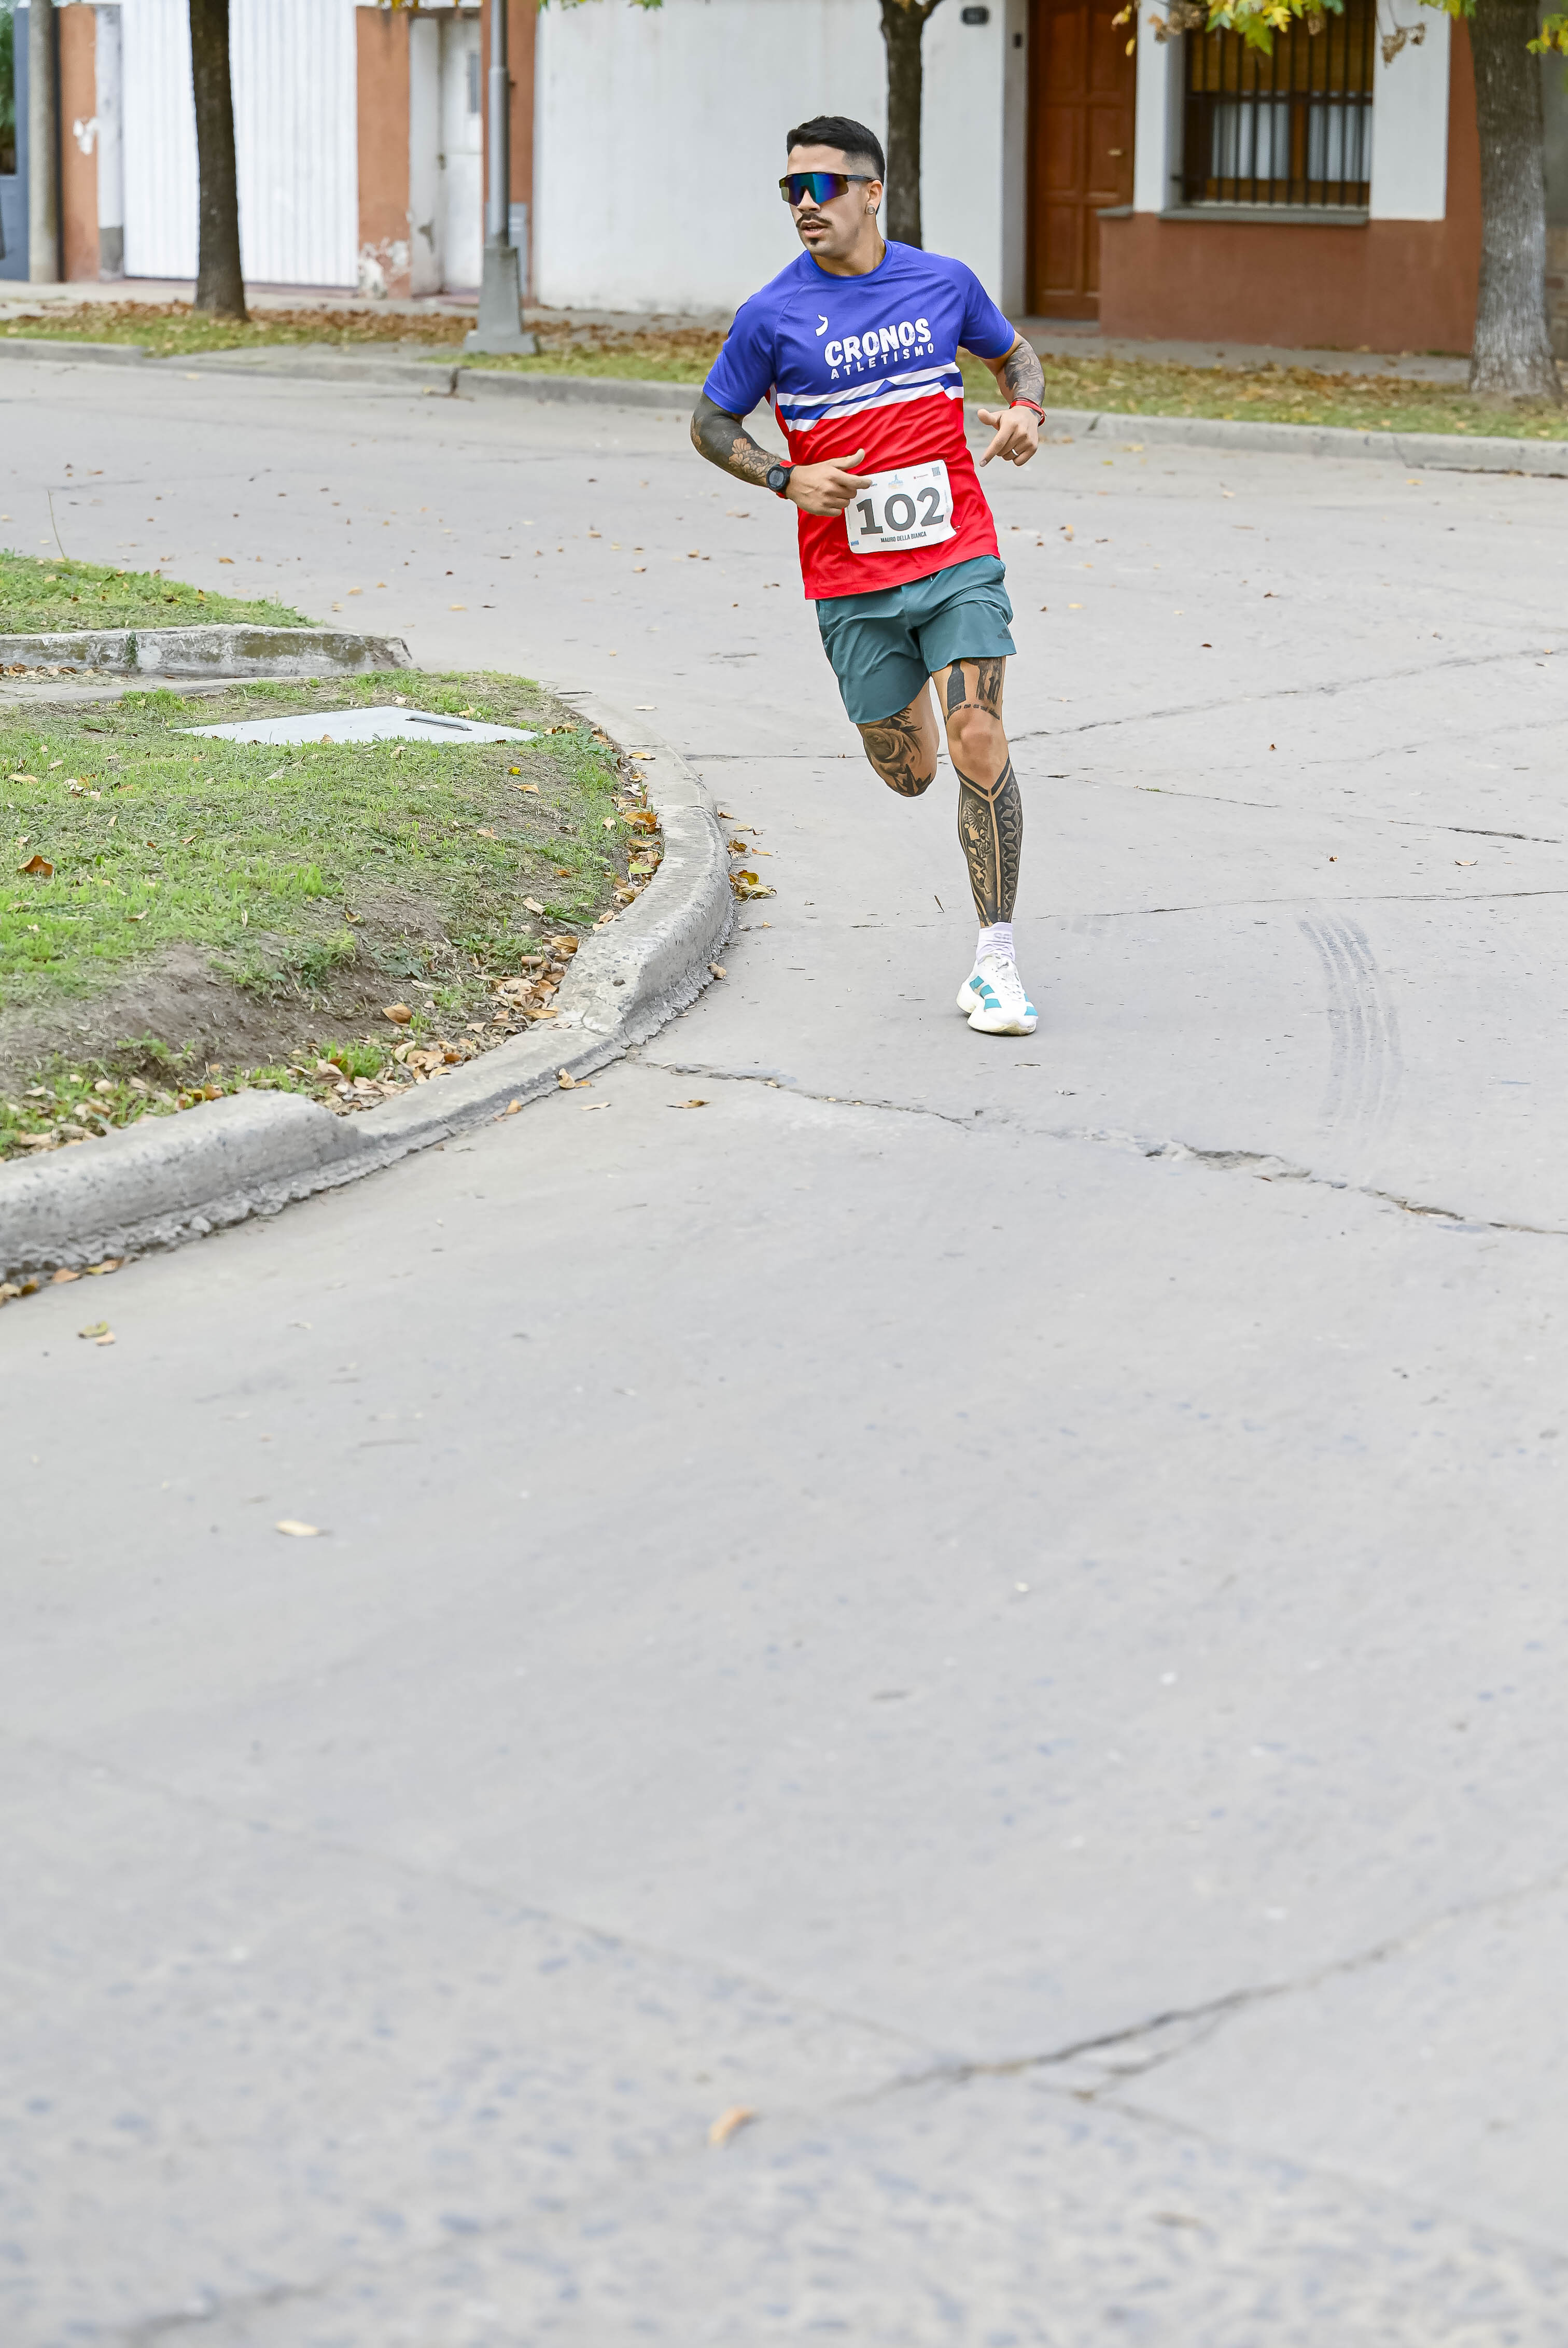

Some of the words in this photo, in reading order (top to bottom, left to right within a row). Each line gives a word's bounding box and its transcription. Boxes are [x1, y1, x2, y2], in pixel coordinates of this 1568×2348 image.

[824, 317, 932, 367] CRONOS
[831, 342, 934, 380] ATLETISMO
[856, 487, 944, 535] 102
[911, 531, 927, 539] BIANCA
